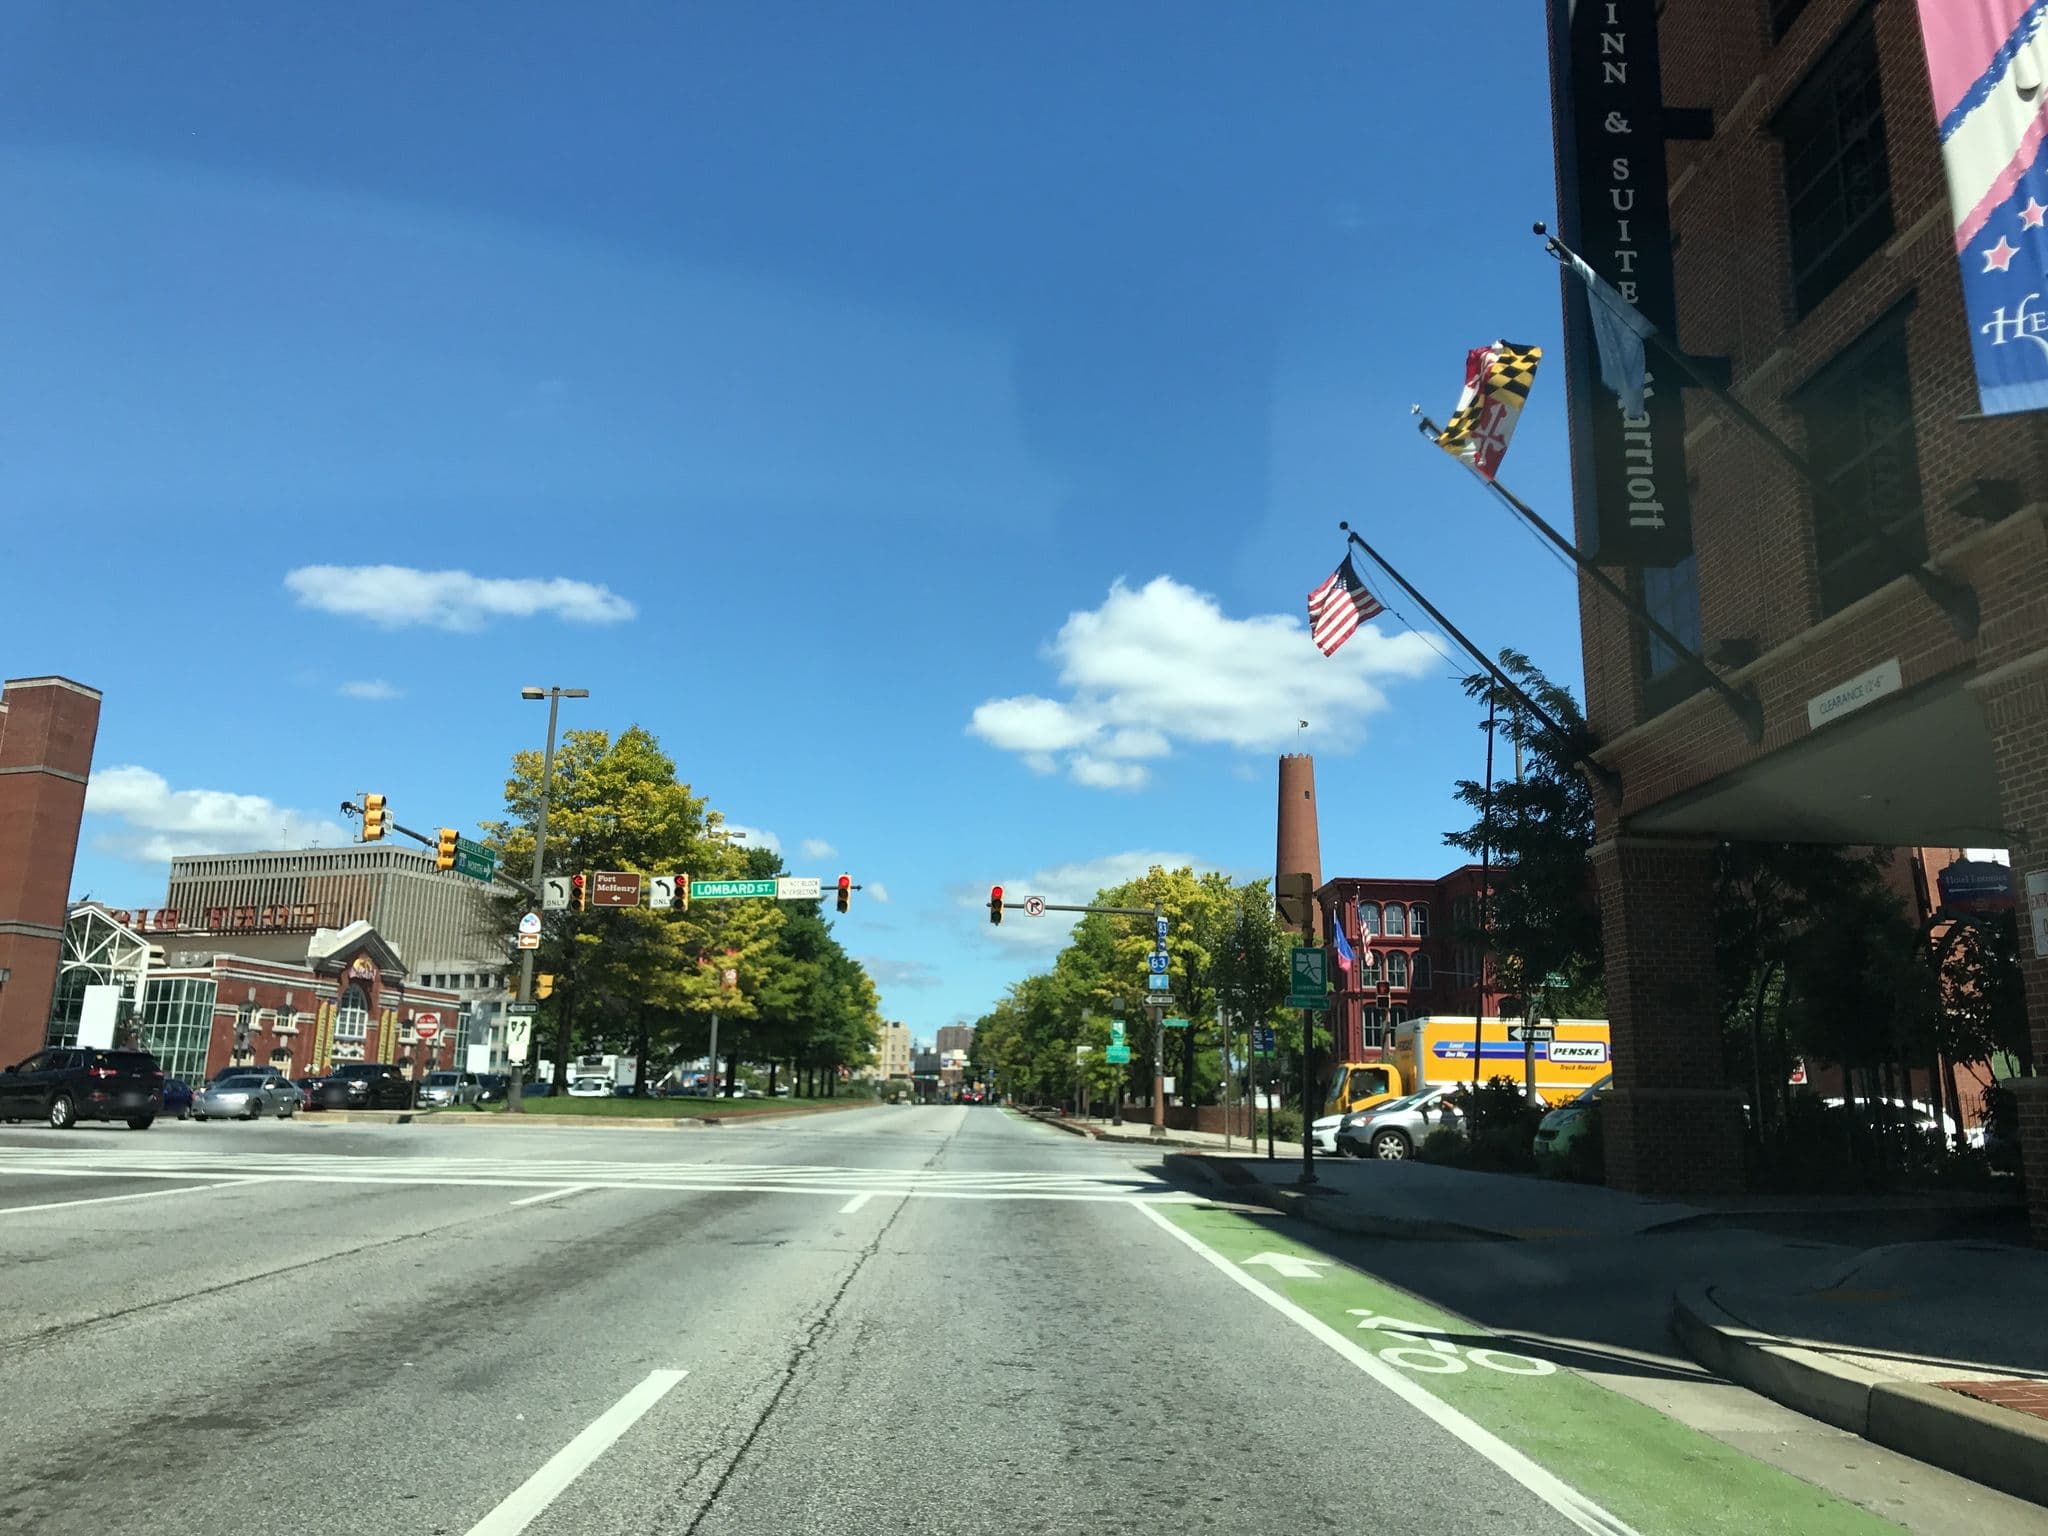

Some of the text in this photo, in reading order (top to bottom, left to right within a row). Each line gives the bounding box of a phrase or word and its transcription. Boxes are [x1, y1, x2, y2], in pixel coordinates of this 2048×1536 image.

[1604, 111, 1632, 134] &
[1608, 157, 1640, 305] SUITE
[1820, 685, 1865, 714] CLEARANCE
[596, 884, 637, 894] McHenry
[697, 883, 756, 896] LOMBARD
[757, 883, 772, 893] ST.
[1151, 958, 1166, 968] 83
[1553, 1047, 1601, 1056] PENSKE
